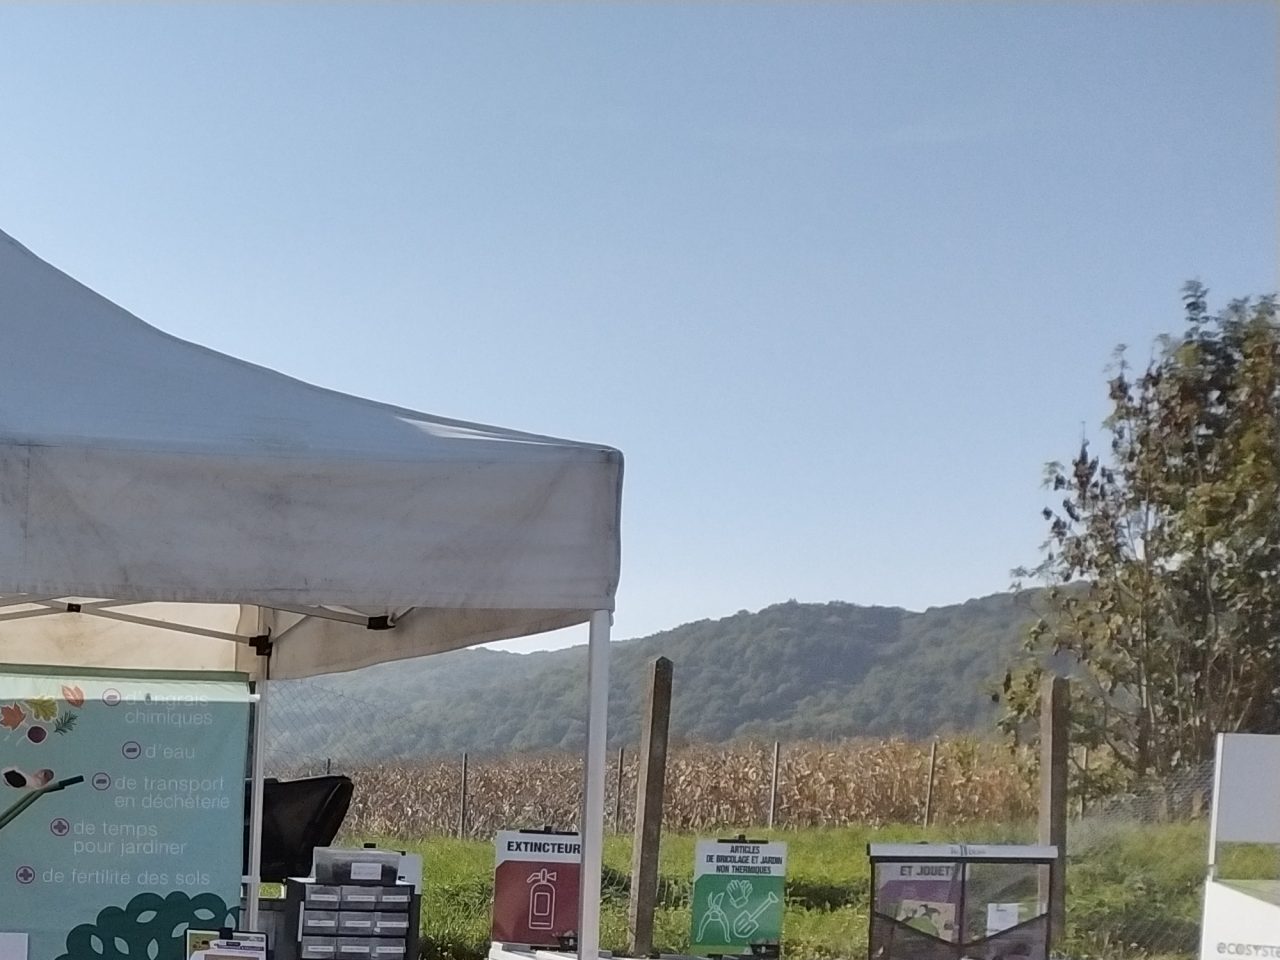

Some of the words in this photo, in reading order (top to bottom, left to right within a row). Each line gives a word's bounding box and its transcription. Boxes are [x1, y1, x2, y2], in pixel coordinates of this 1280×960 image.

[125, 709, 213, 728] chimiques
[114, 776, 137, 790] de
[144, 776, 224, 793] transport
[114, 795, 135, 808] en
[74, 822, 95, 835] de
[103, 823, 158, 839] temps
[74, 841, 115, 856] pour
[121, 839, 187, 856] jardiner
[507, 840, 581, 854] EXTINCTEUR
[730, 845, 760, 854] ARTICLES
[706, 855, 714, 863] DE
[716, 855, 750, 864] BRICOLAGE
[751, 856, 759, 864] ET
[760, 856, 782, 865] JARDIN
[43, 868, 64, 883] de
[72, 868, 130, 885] fertilité
[137, 871, 169, 885] des
[175, 870, 210, 886] sols
[716, 865, 730, 873] NON
[731, 865, 772, 875] THERMIQUES
[900, 865, 913, 876] ET
